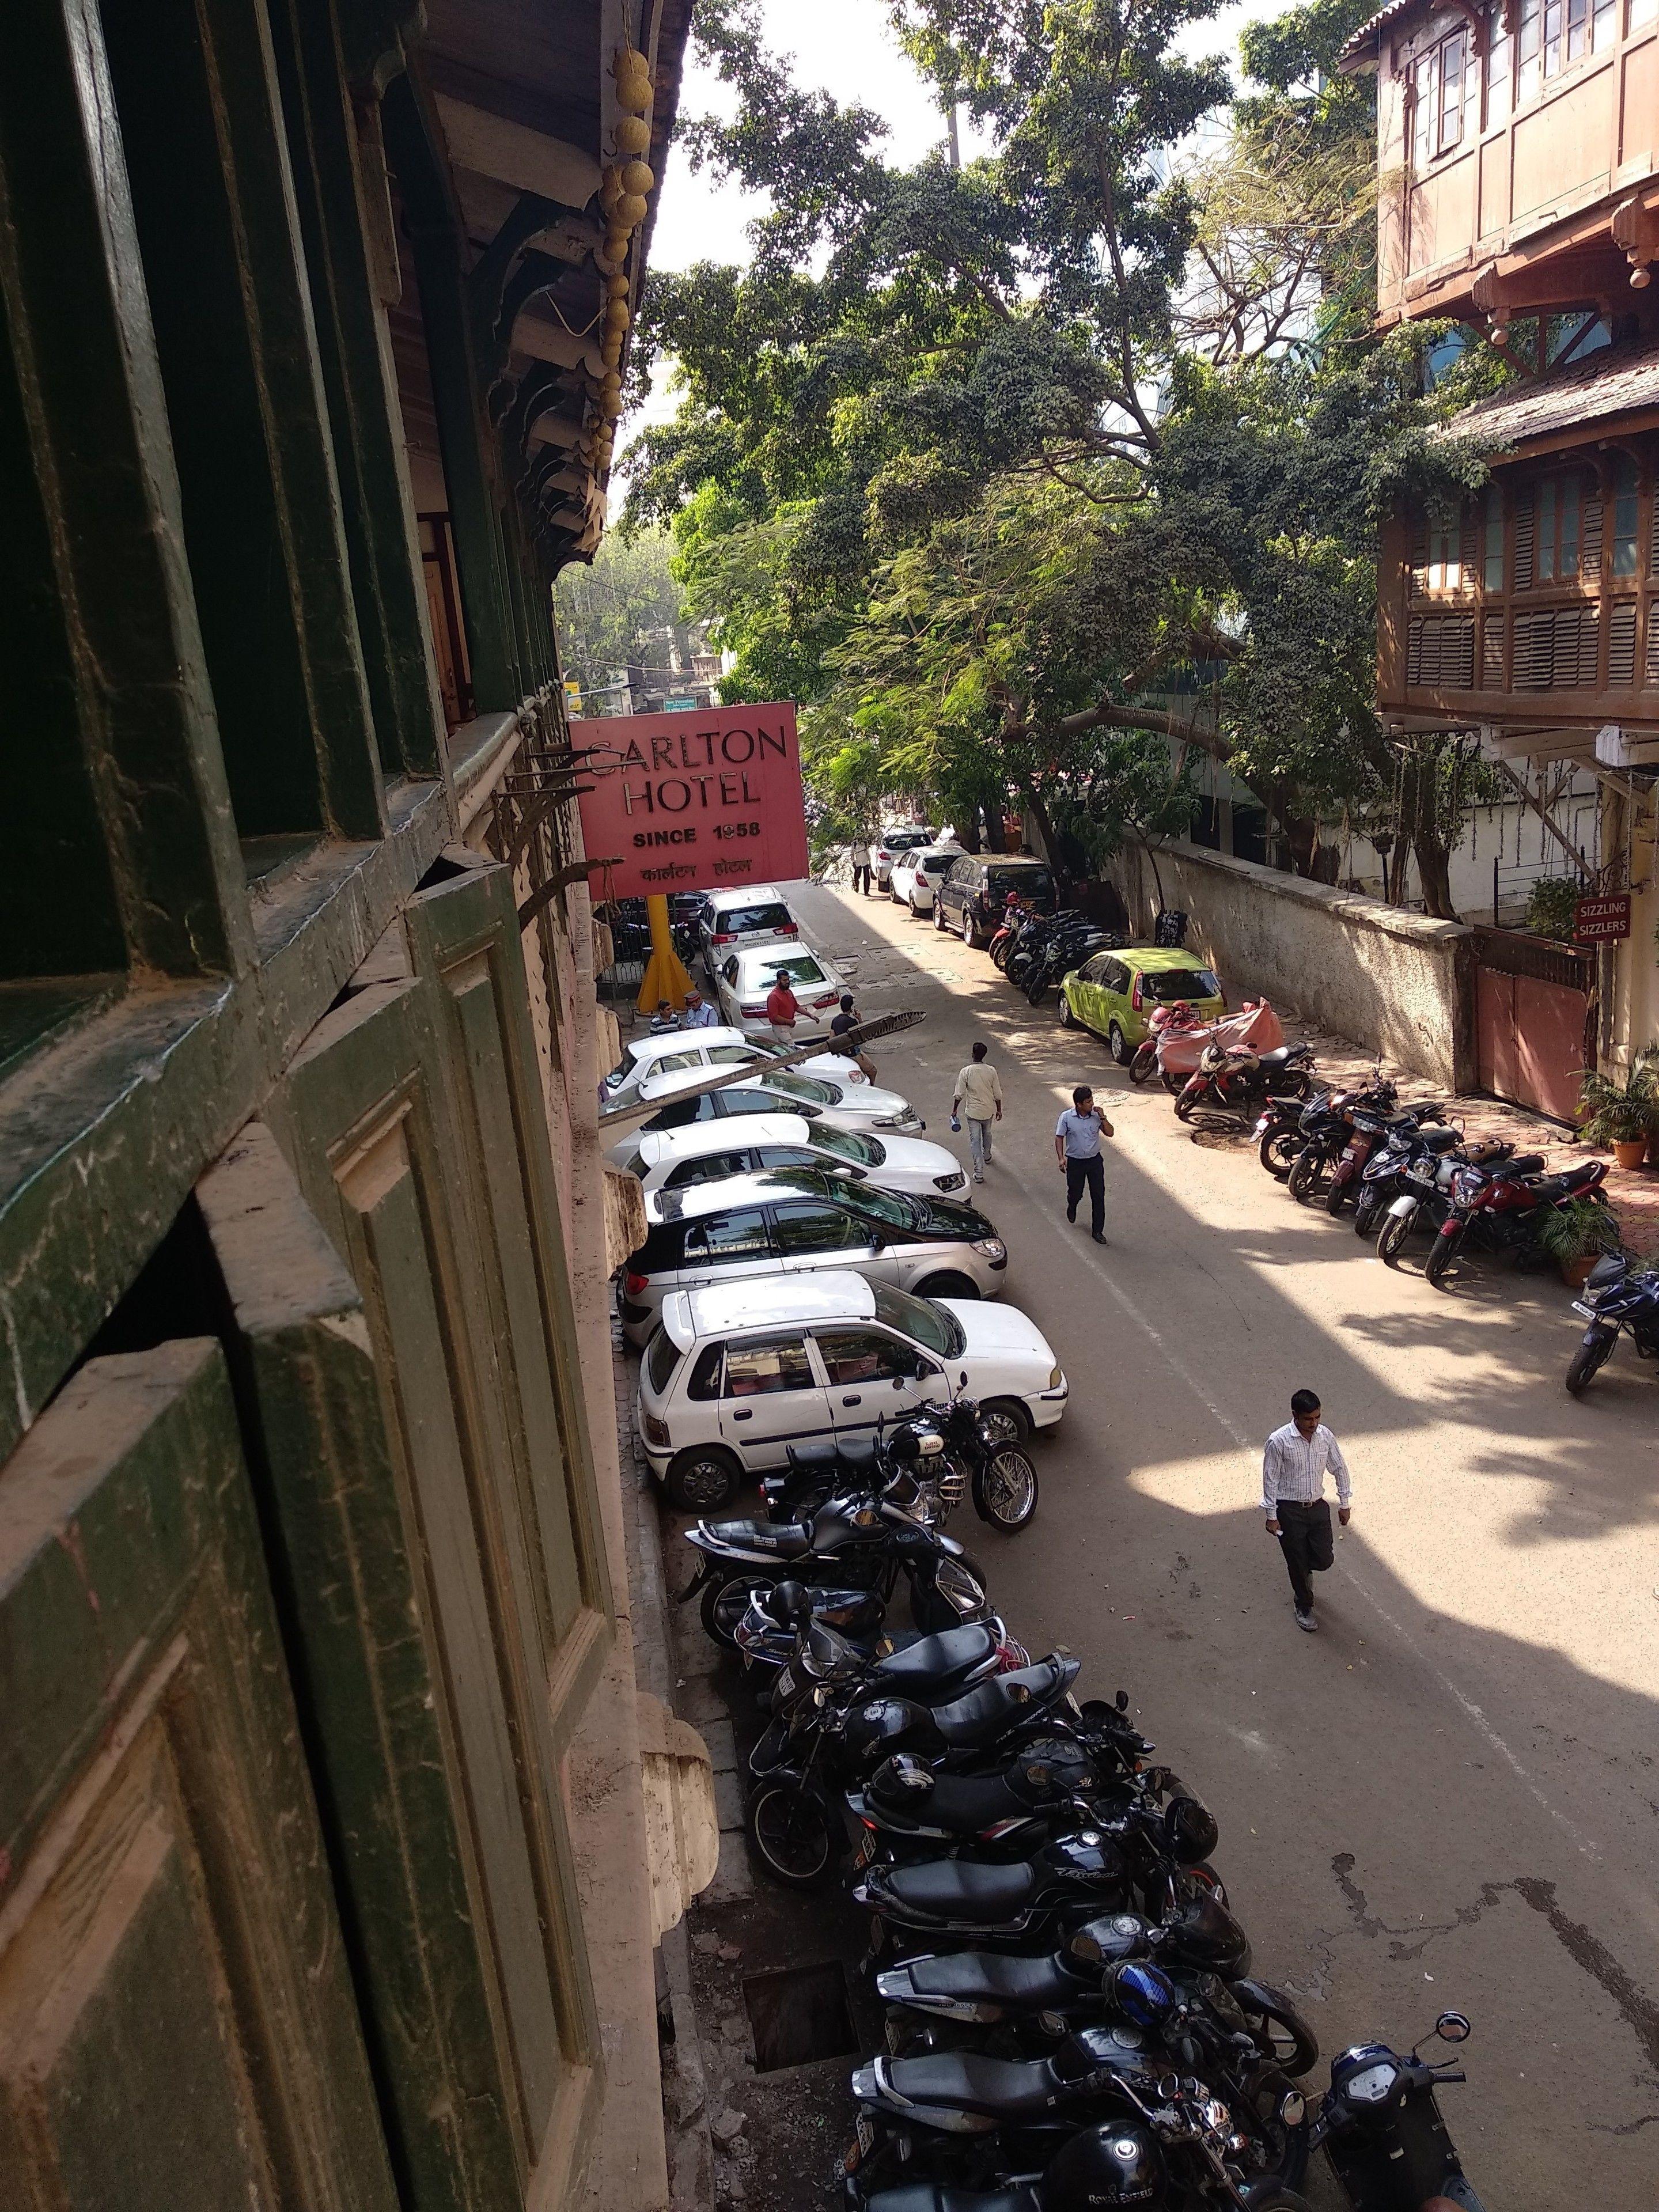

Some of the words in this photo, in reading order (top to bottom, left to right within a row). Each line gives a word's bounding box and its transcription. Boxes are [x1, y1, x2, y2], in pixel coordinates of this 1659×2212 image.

[584, 725, 787, 775] CARLTON
[623, 771, 761, 815] HOTEL
[633, 827, 697, 848] SINCE
[713, 821, 760, 840] 1958
[1580, 901, 1627, 918] SIZZLING
[1580, 920, 1627, 937] SIZZLERS
